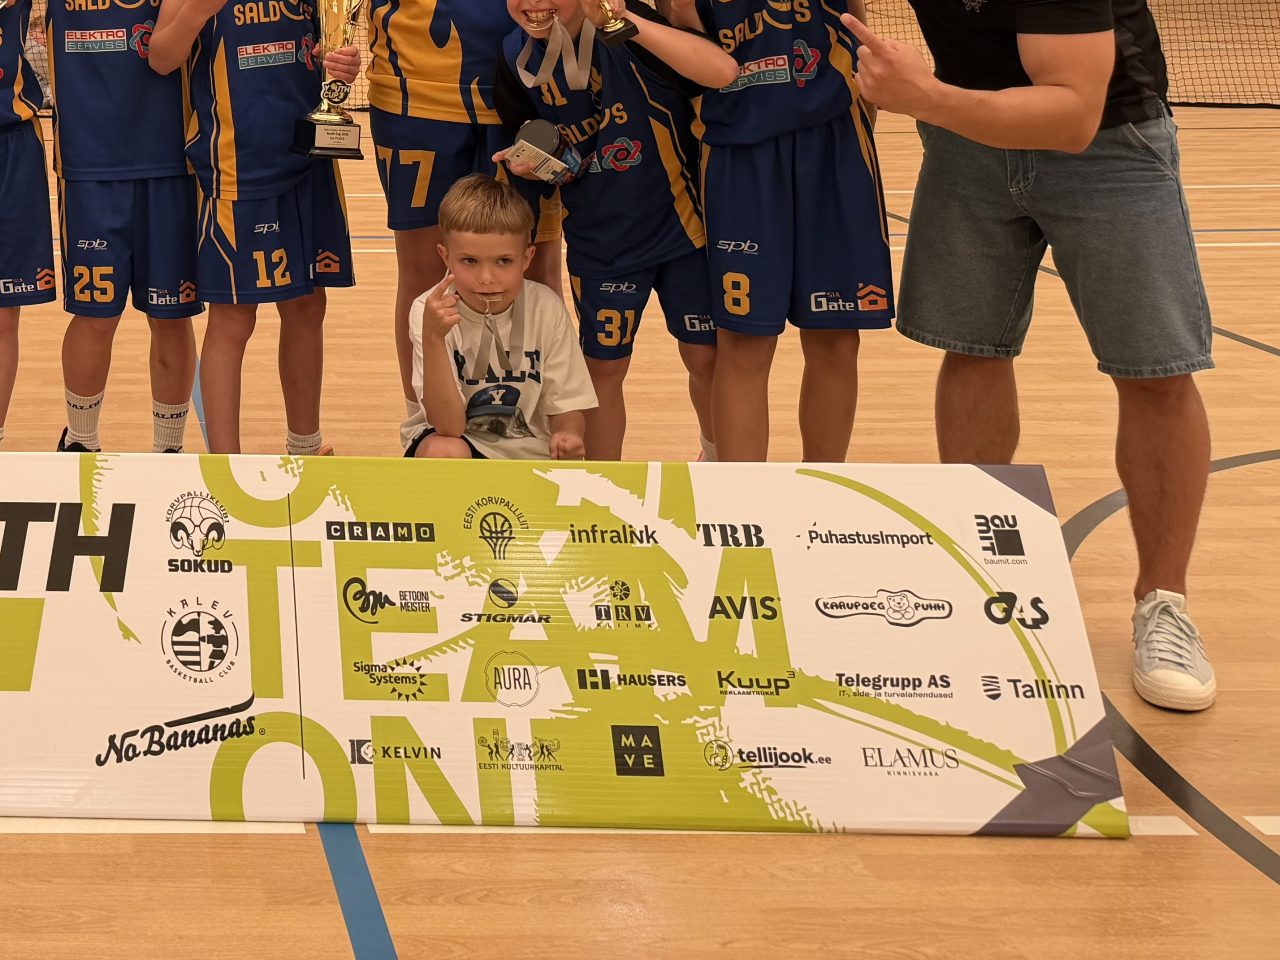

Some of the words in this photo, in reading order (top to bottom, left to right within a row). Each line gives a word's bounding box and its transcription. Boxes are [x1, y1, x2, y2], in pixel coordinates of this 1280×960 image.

[66, 30, 126, 41] ELEKTRO
[67, 41, 126, 51] SERVISS
[238, 42, 295, 57] ELEKTRO
[239, 53, 294, 68] SERVISS
[77, 238, 108, 251] spb
[716, 239, 759, 254] spb
[252, 248, 292, 288] 12
[72, 265, 115, 303] 25
[599, 281, 637, 293] spb
[147, 287, 178, 306] Gate
[722, 271, 751, 317] 8
[809, 291, 855, 313] Gate
[596, 308, 636, 347] 31
[683, 313, 717, 332] Gat
[488, 389, 506, 405] Y
[328, 523, 433, 541] CRAMO
[570, 523, 659, 545] infralink
[696, 523, 765, 547] TRB
[807, 530, 934, 548] PuhastusImport
[167, 558, 234, 573] SOKUD
[983, 557, 1028, 565] baumit.com
[398, 590, 430, 602] BETOONI
[166, 596, 234, 620] KALEV
[399, 601, 431, 613] MEISTER
[596, 605, 651, 621] TRV
[708, 596, 778, 621] AVIS
[822, 600, 886, 611] KARUPOEG
[460, 613, 551, 624] STIGMAR
[165, 658, 214, 684] BASKETBALL
[218, 660, 237, 678] CLUB
[353, 661, 388, 675] Sigma
[369, 672, 418, 687] Systems
[493, 666, 532, 690] AURA
[617, 673, 687, 687] HAUSERS
[835, 673, 922, 690] Telegrupp
[927, 674, 951, 689] AS
[1006, 678, 1085, 700] Tallinn
[95, 729, 141, 767] No
[140, 715, 256, 757] Bananas
[381, 745, 442, 759] KELVIN
[736, 746, 832, 767] tellijook.ee
[861, 746, 960, 769] ELAMUS
[478, 762, 500, 770] EESTI
[501, 763, 565, 771] KULTUURKAPITAL
